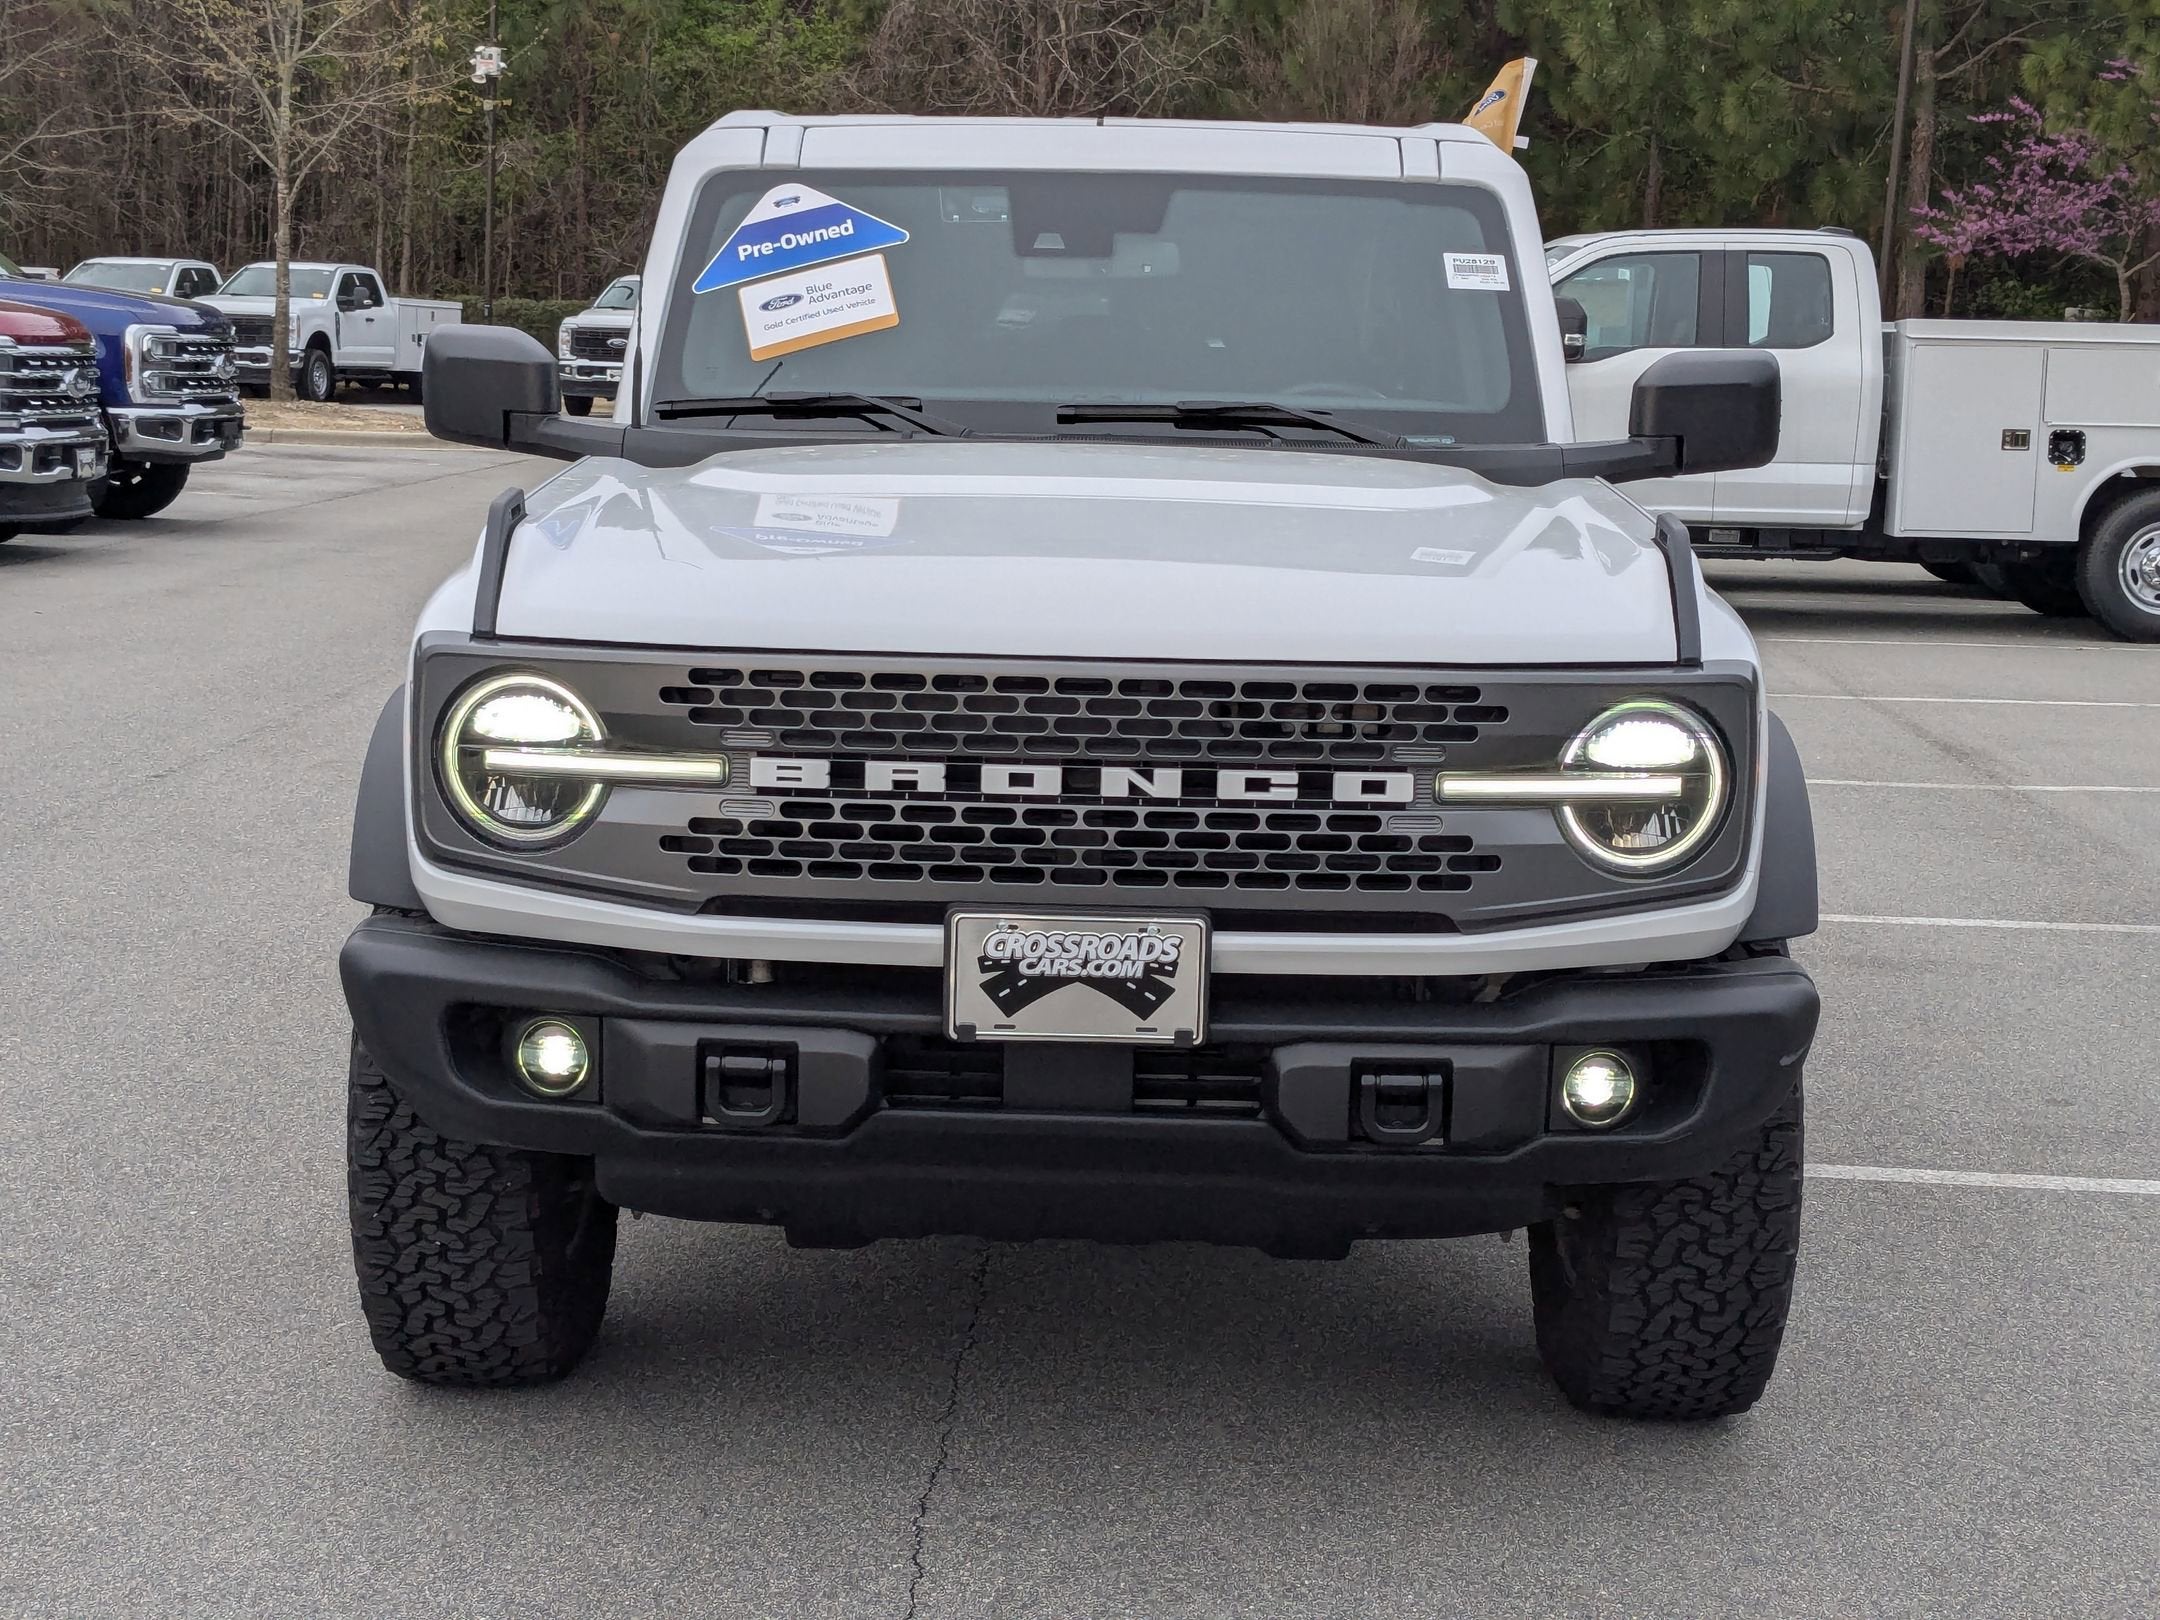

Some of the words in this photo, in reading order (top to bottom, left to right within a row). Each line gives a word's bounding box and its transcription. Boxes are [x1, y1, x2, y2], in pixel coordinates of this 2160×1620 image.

[737, 219, 855, 262] Pre-Owned
[805, 281, 833, 295] Blue
[808, 282, 873, 305] Advantage
[763, 320, 784, 331] Gold
[785, 310, 821, 325] Certified
[822, 304, 844, 316] Used
[846, 297, 877, 310] Vehicle
[750, 756, 1414, 802] BRONCO
[985, 931, 1183, 963] CROSSROADS
[1018, 958, 1145, 979] CARS.COM
